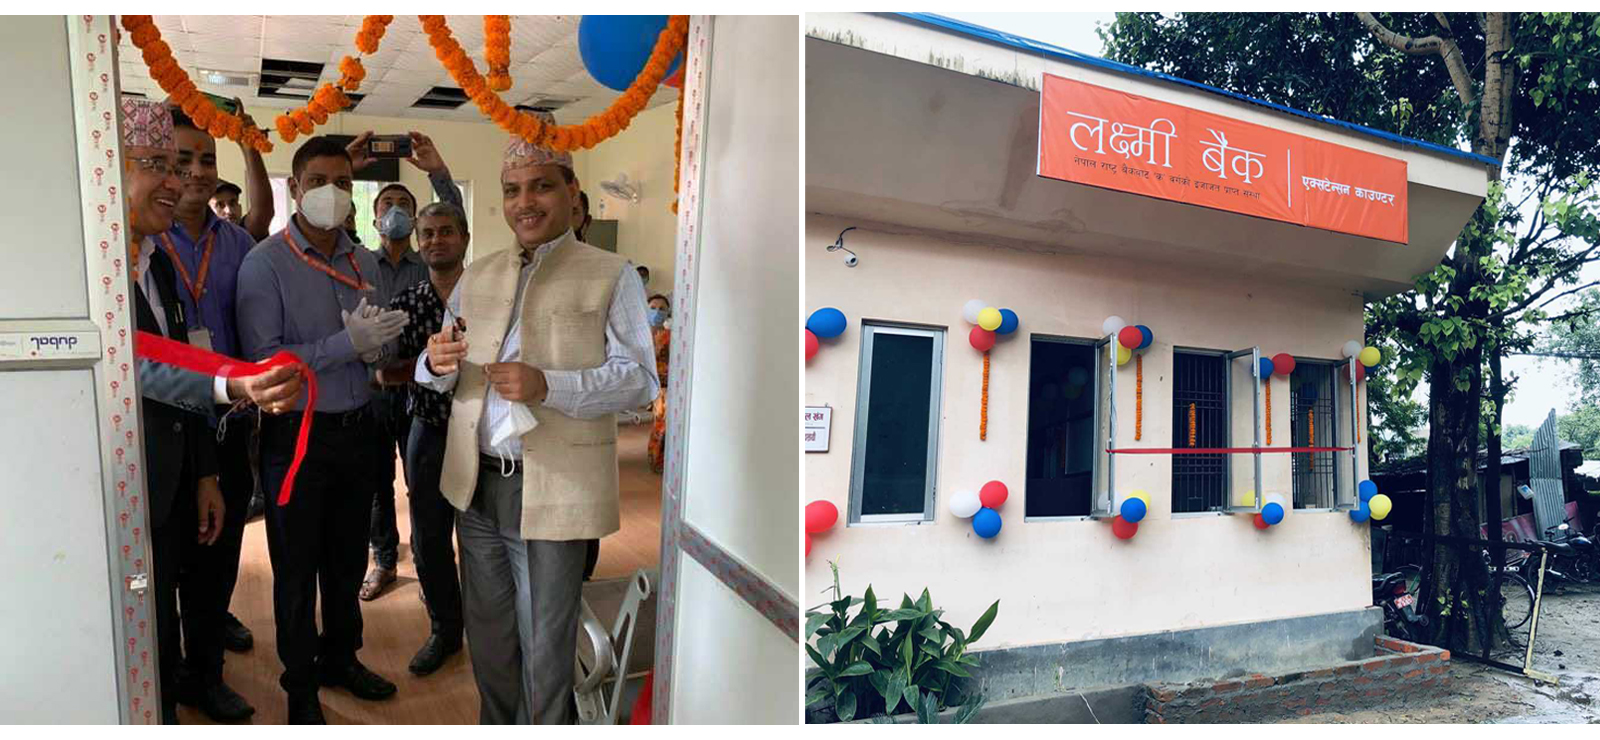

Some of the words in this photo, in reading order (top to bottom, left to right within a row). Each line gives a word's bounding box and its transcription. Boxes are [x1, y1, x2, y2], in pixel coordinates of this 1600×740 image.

[1067, 111, 1178, 168] लक्ष्मी
[1074, 155, 1096, 169] नेपाल
[1301, 175, 1351, 196] एक्सटेन्सन
[1354, 186, 1395, 206] काउण्टर
